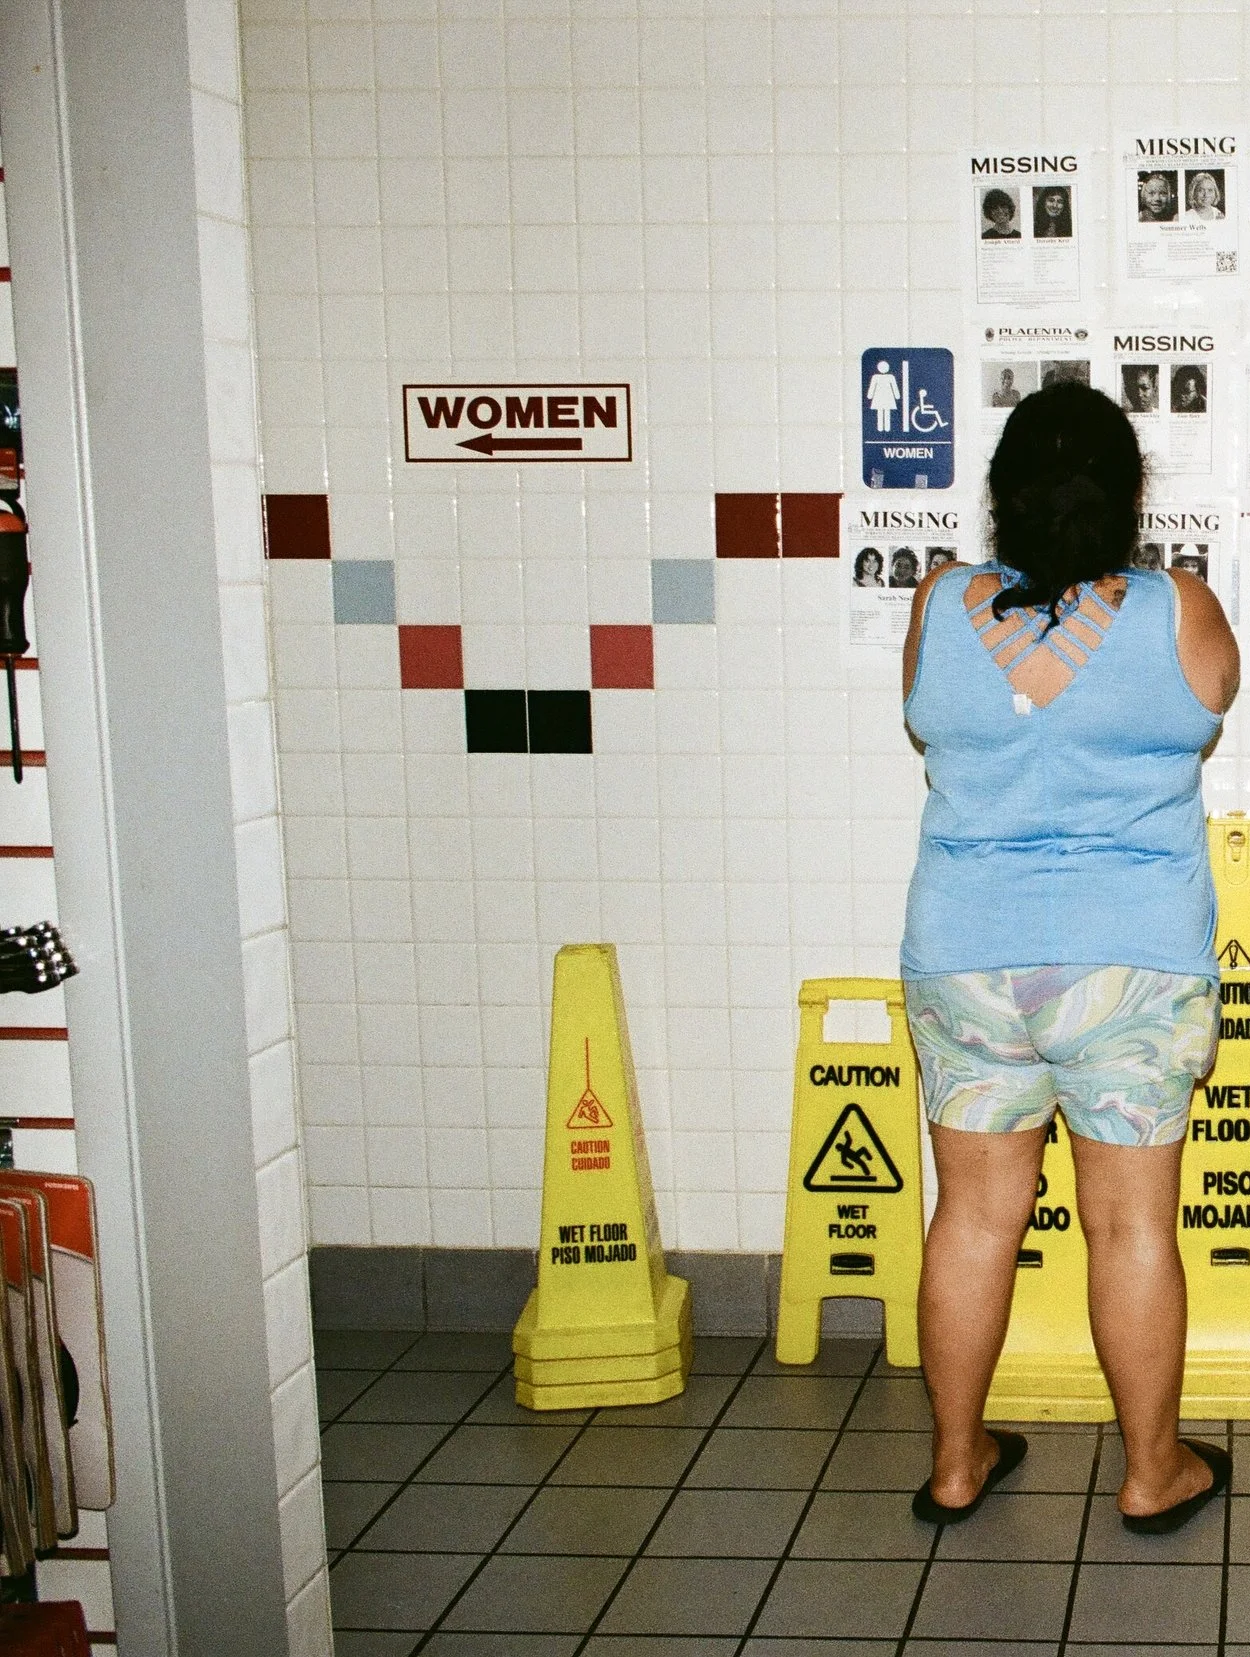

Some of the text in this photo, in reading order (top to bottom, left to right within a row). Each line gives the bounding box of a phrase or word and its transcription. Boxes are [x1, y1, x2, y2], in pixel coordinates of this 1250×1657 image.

[1135, 137, 1236, 156] MISSING
[971, 156, 1078, 174] MISSING
[1113, 336, 1214, 351] MISSING
[417, 395, 617, 429] WOMEN
[883, 447, 934, 459] WOMEN
[860, 511, 958, 529] MISSING
[809, 1065, 900, 1087] CAUTION
[571, 1140, 610, 1154] CAUTION
[572, 1156, 610, 1170] CUIDADO
[837, 1204, 869, 1219] WET
[559, 1223, 628, 1243] WET FLOOR
[828, 1223, 877, 1239] FLOOR
[551, 1243, 637, 1264] PISO MOJADO
